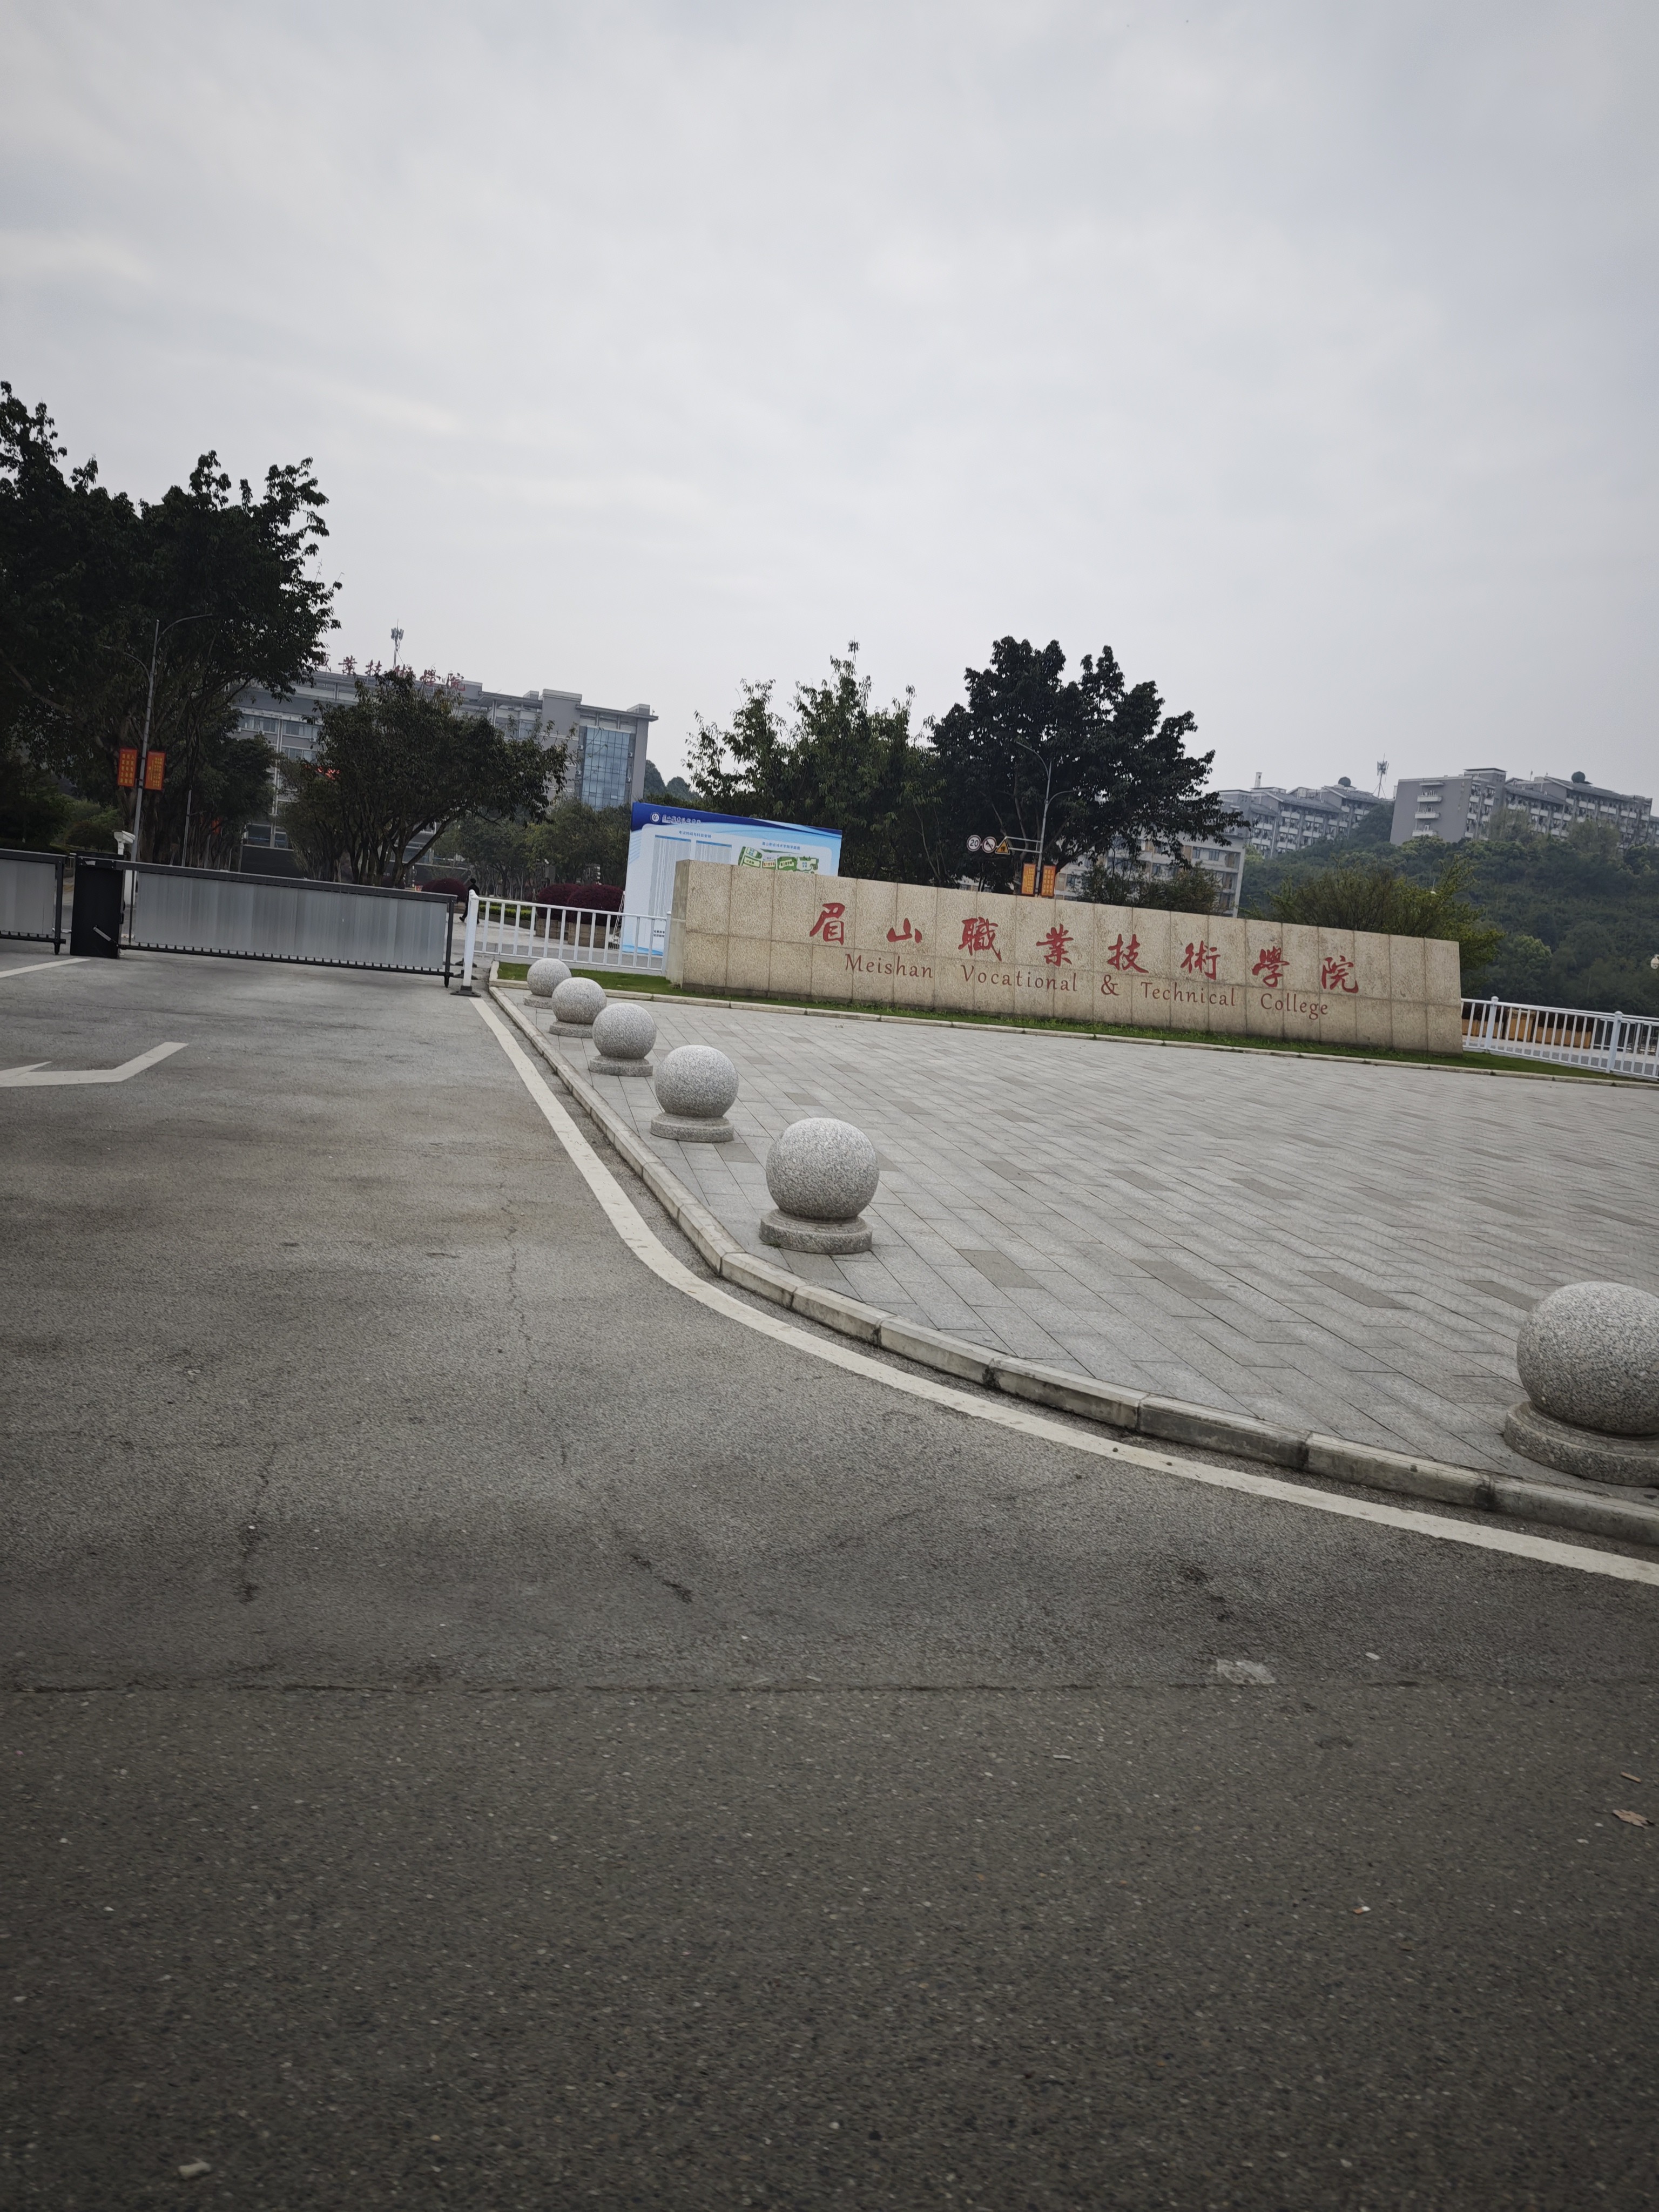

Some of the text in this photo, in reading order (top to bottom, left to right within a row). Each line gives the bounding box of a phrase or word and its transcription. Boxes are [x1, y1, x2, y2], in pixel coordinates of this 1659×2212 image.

[970, 839, 979, 847] 20
[810, 902, 1359, 994] 眉山職業技術學院
[845, 953, 1329, 1020] Meishan Vocational & Technical College
